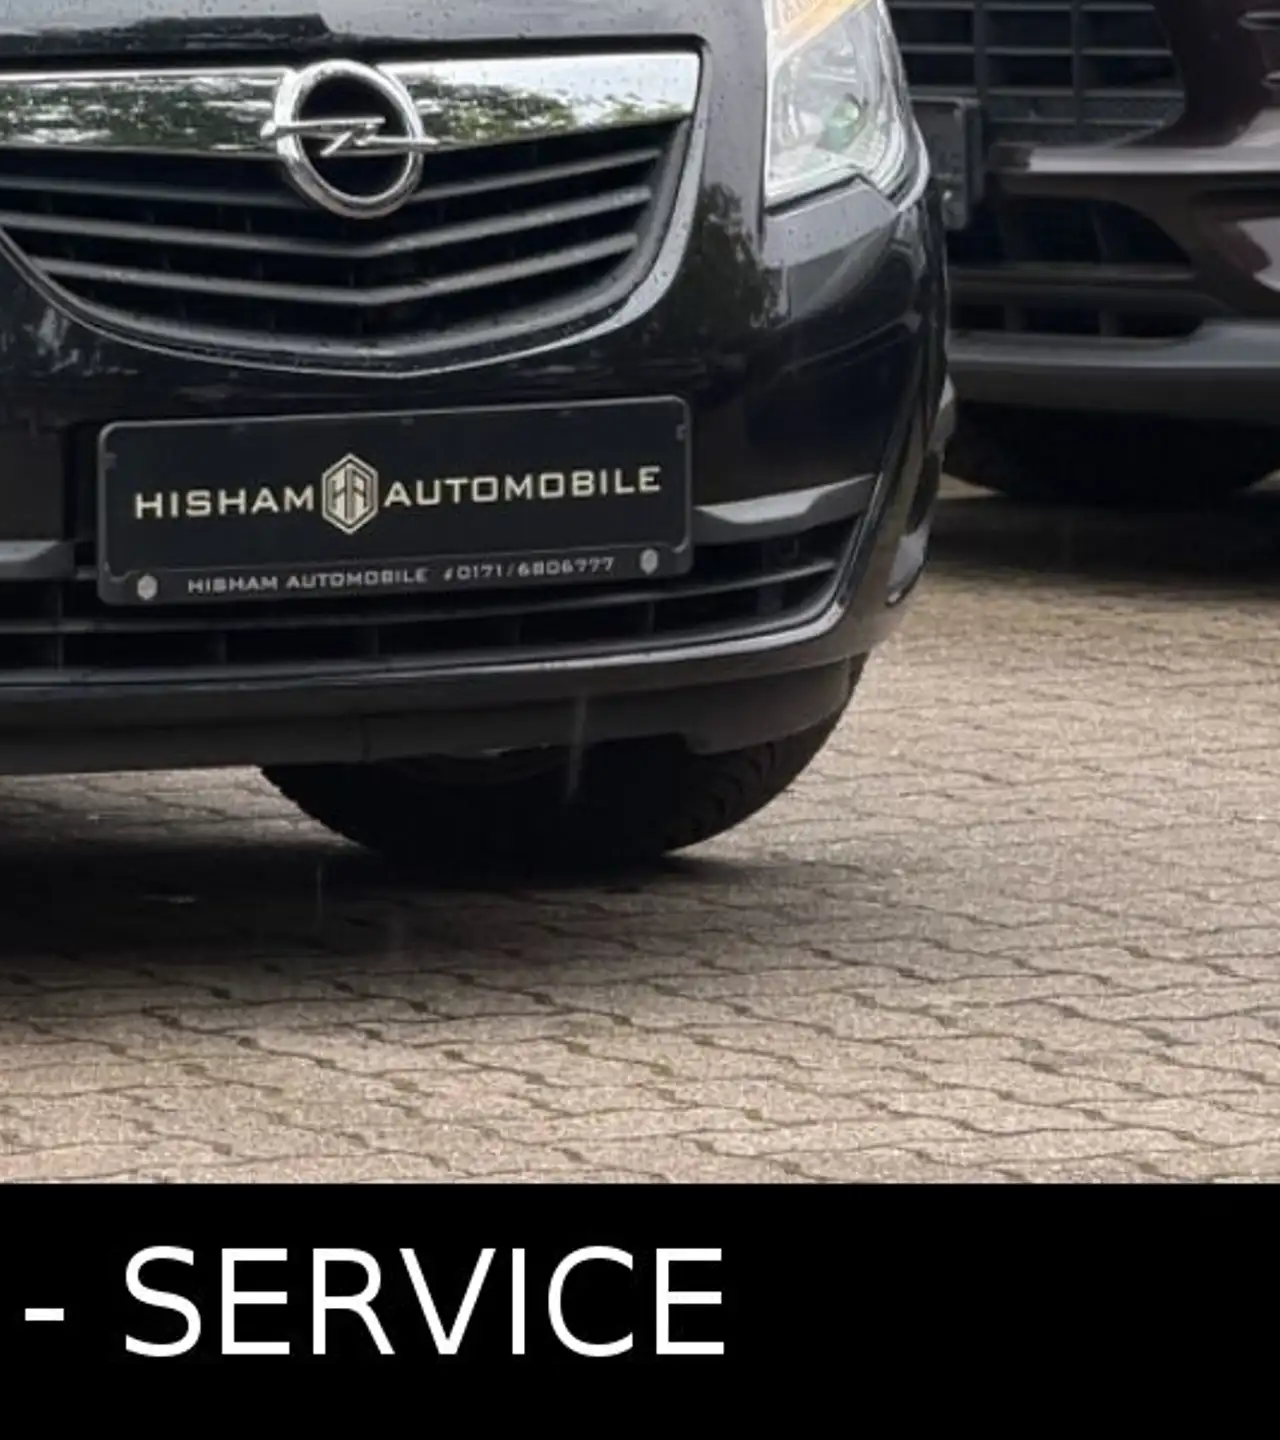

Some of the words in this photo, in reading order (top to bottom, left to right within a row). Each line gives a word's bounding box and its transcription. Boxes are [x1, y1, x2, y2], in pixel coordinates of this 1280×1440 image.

[134, 484, 315, 520] HISHAM
[383, 465, 662, 508] AUTOMOBILE
[187, 576, 278, 594] HISHAM
[286, 567, 429, 590] AUTOMOBILE
